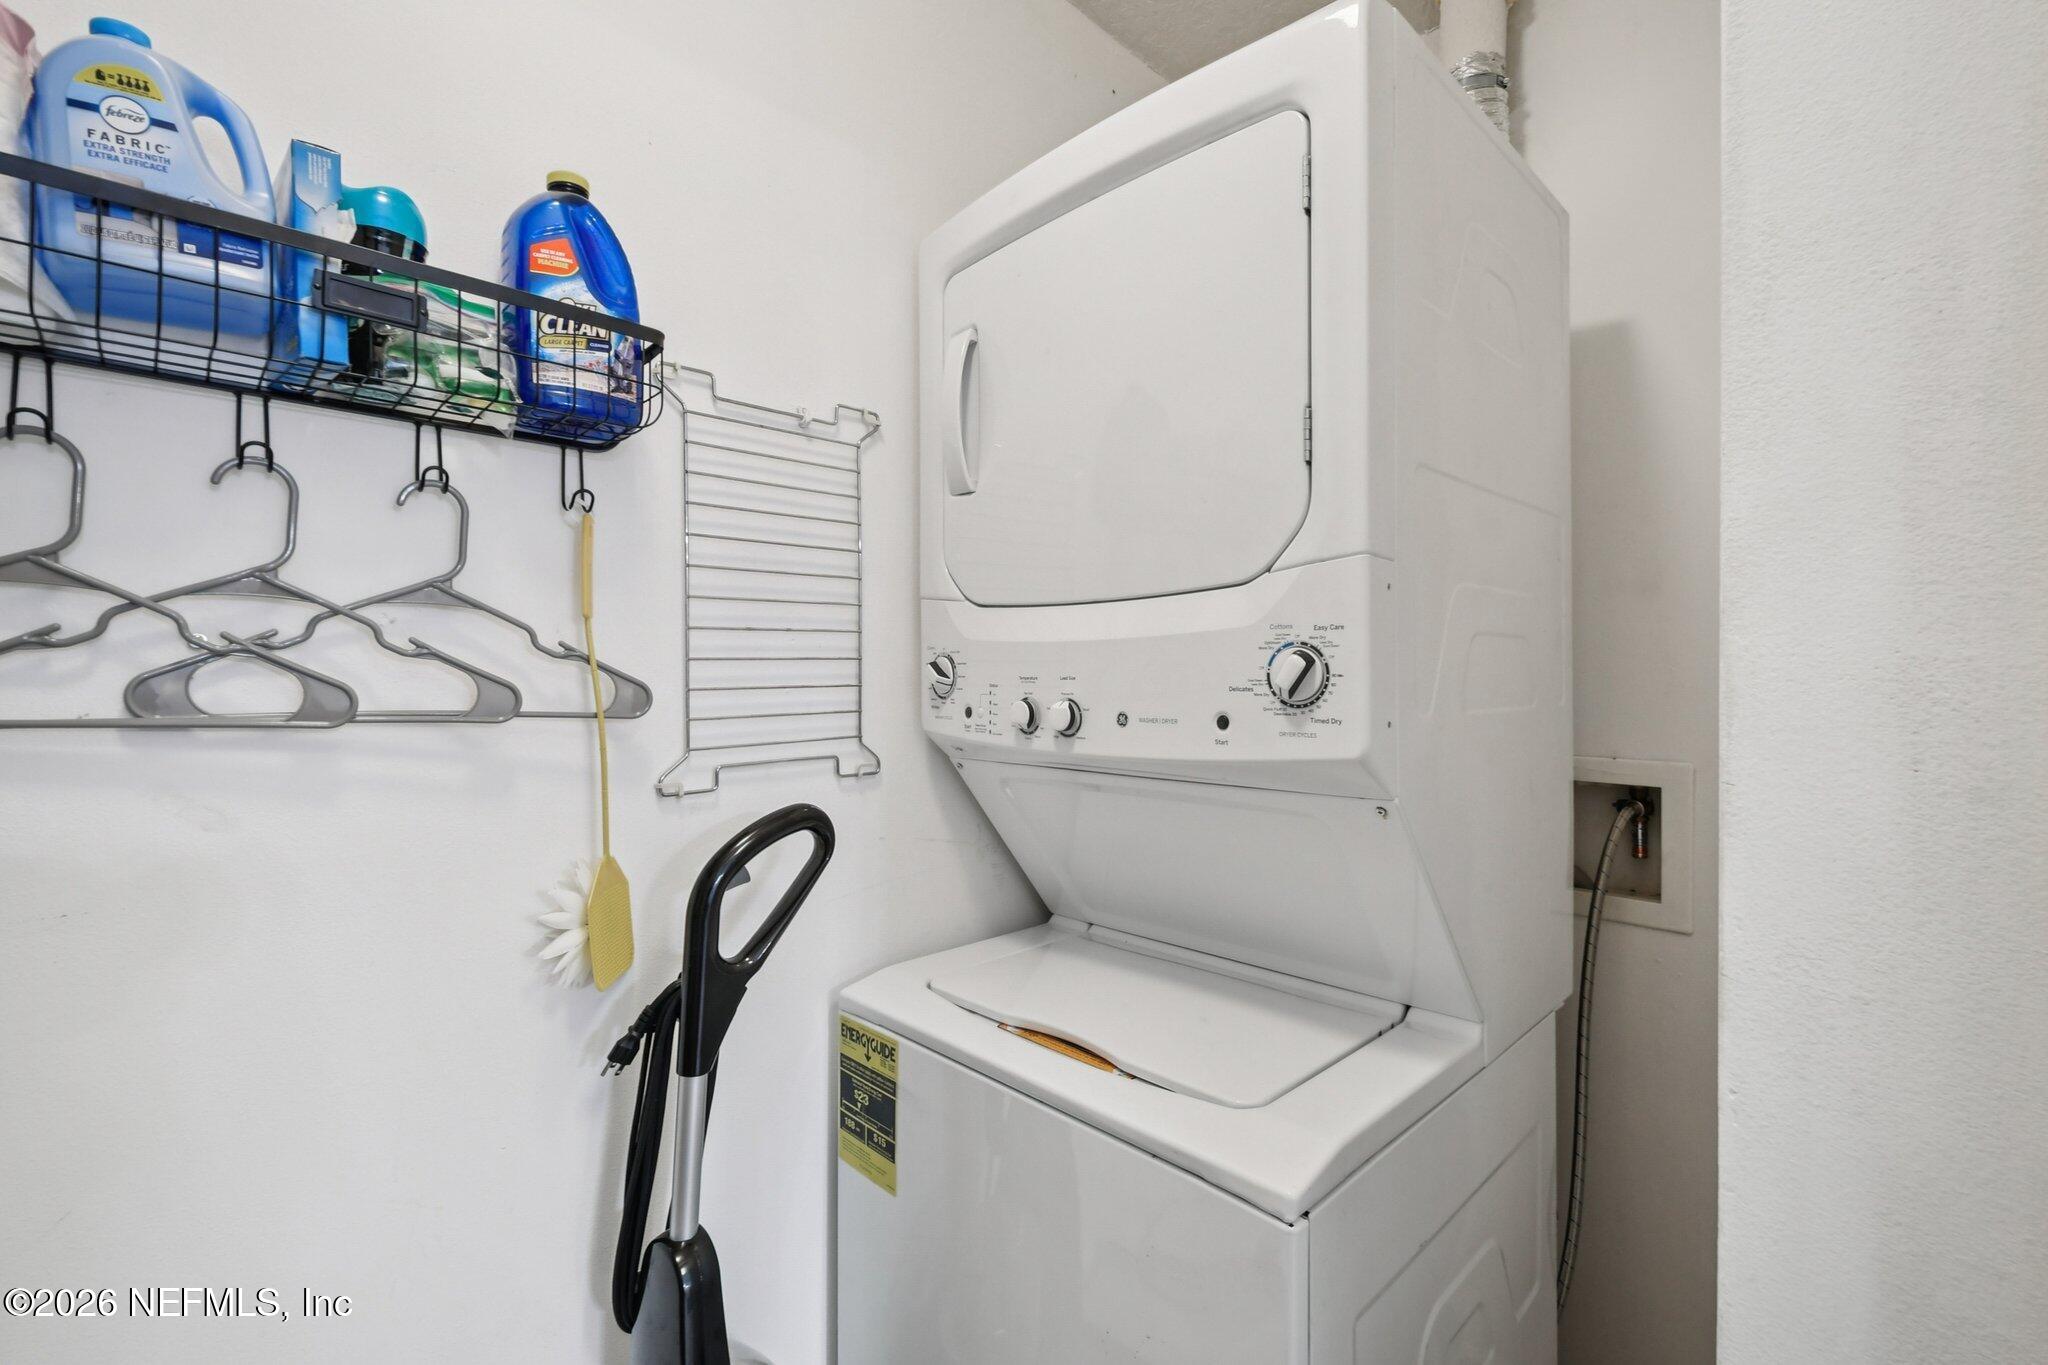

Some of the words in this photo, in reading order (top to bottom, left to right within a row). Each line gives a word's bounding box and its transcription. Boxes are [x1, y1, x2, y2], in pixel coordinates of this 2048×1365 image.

[105, 104, 146, 123] febreze
[83, 139, 117, 153] EXTRA
[119, 147, 171, 165] STRENGTH
[87, 149, 120, 163] EXTRA
[123, 157, 169, 174] EFFICACE
[1269, 623, 1293, 631] Cottons
[1313, 624, 1328, 632] Easy
[1328, 623, 1345, 631] Care
[1310, 717, 1330, 725] Timed
[1330, 717, 1342, 726] Dry
[1214, 738, 1229, 746] Start
[841, 1022, 896, 1063] ENERGYGUIDE
